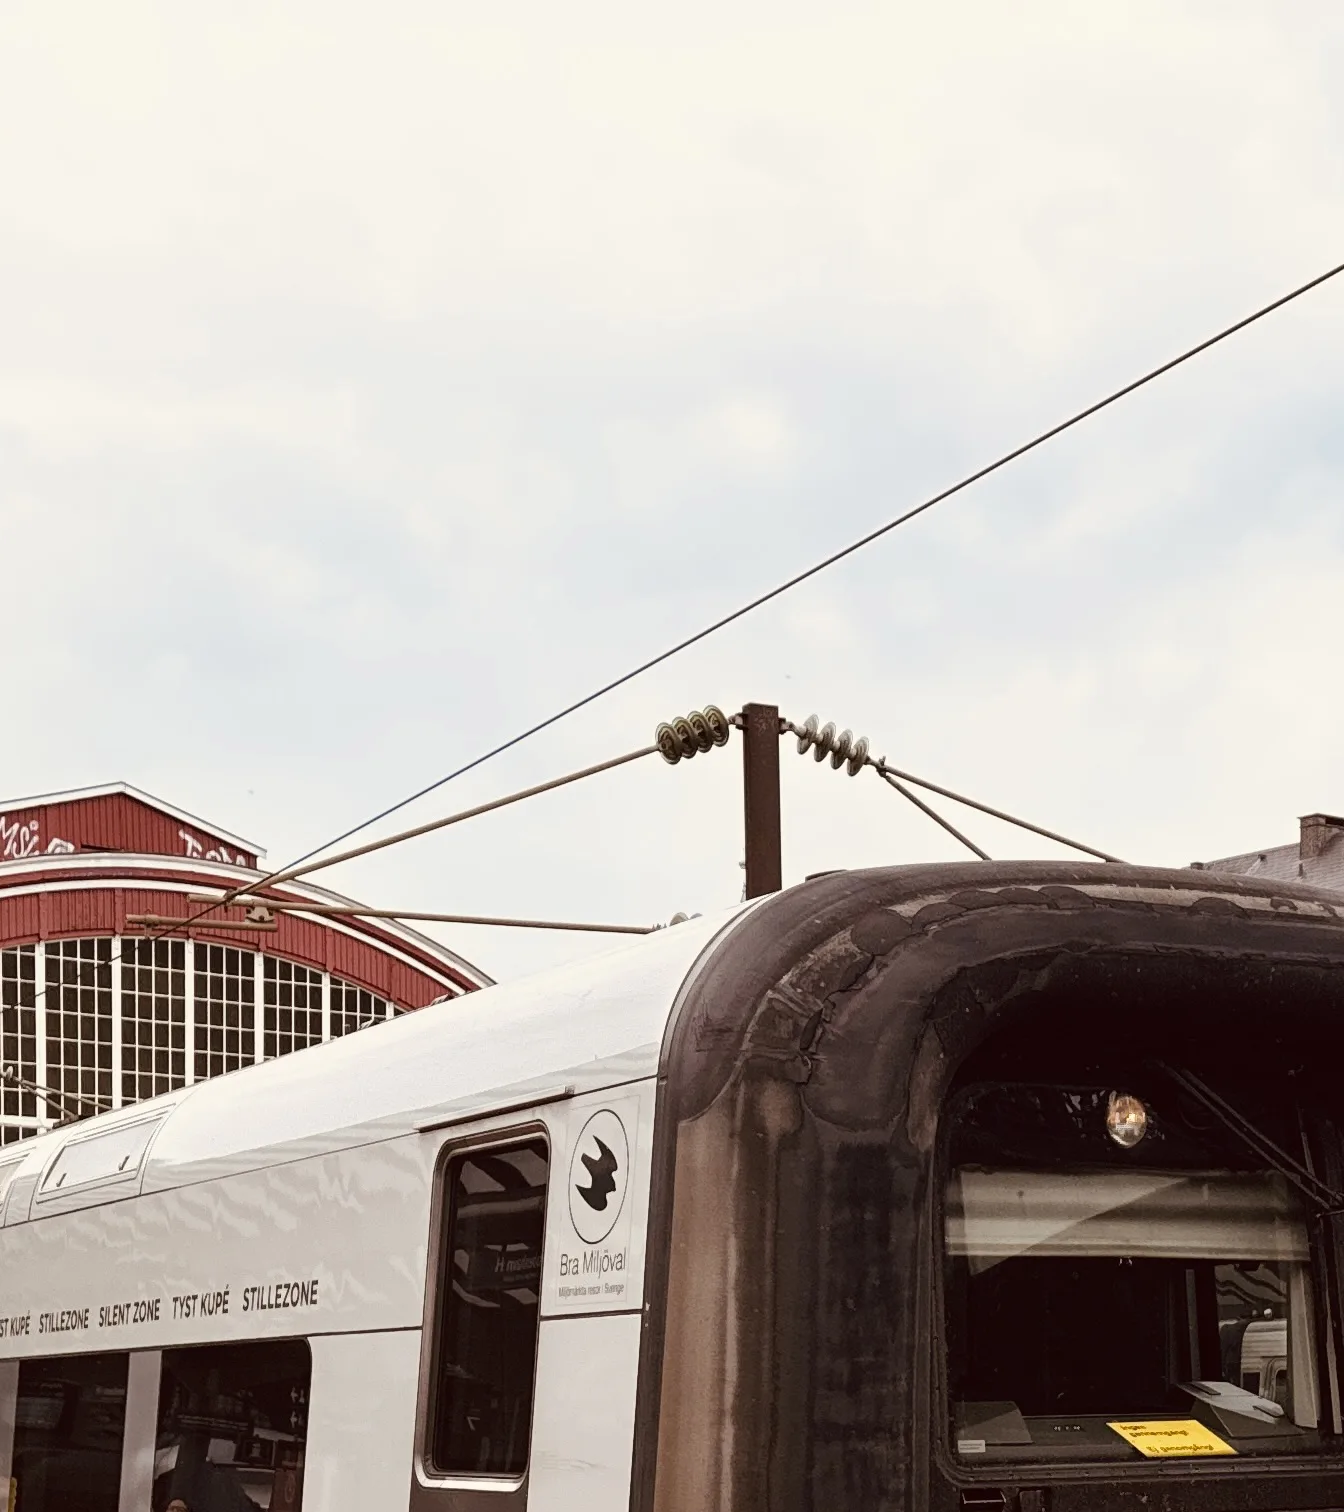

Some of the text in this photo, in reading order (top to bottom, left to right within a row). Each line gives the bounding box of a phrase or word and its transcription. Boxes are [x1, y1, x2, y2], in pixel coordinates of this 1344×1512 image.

[560, 1253, 579, 1276] Bra
[582, 1247, 626, 1279] Miljöval
[10, 1310, 30, 1337] KUPÉ
[39, 1308, 90, 1334] STILLEZONE
[98, 1303, 132, 1328] SILENT
[132, 1298, 161, 1323] ZONE
[172, 1294, 198, 1320] TYST
[200, 1284, 230, 1316] KUPÉ
[242, 1280, 319, 1312] STILLEZONE
